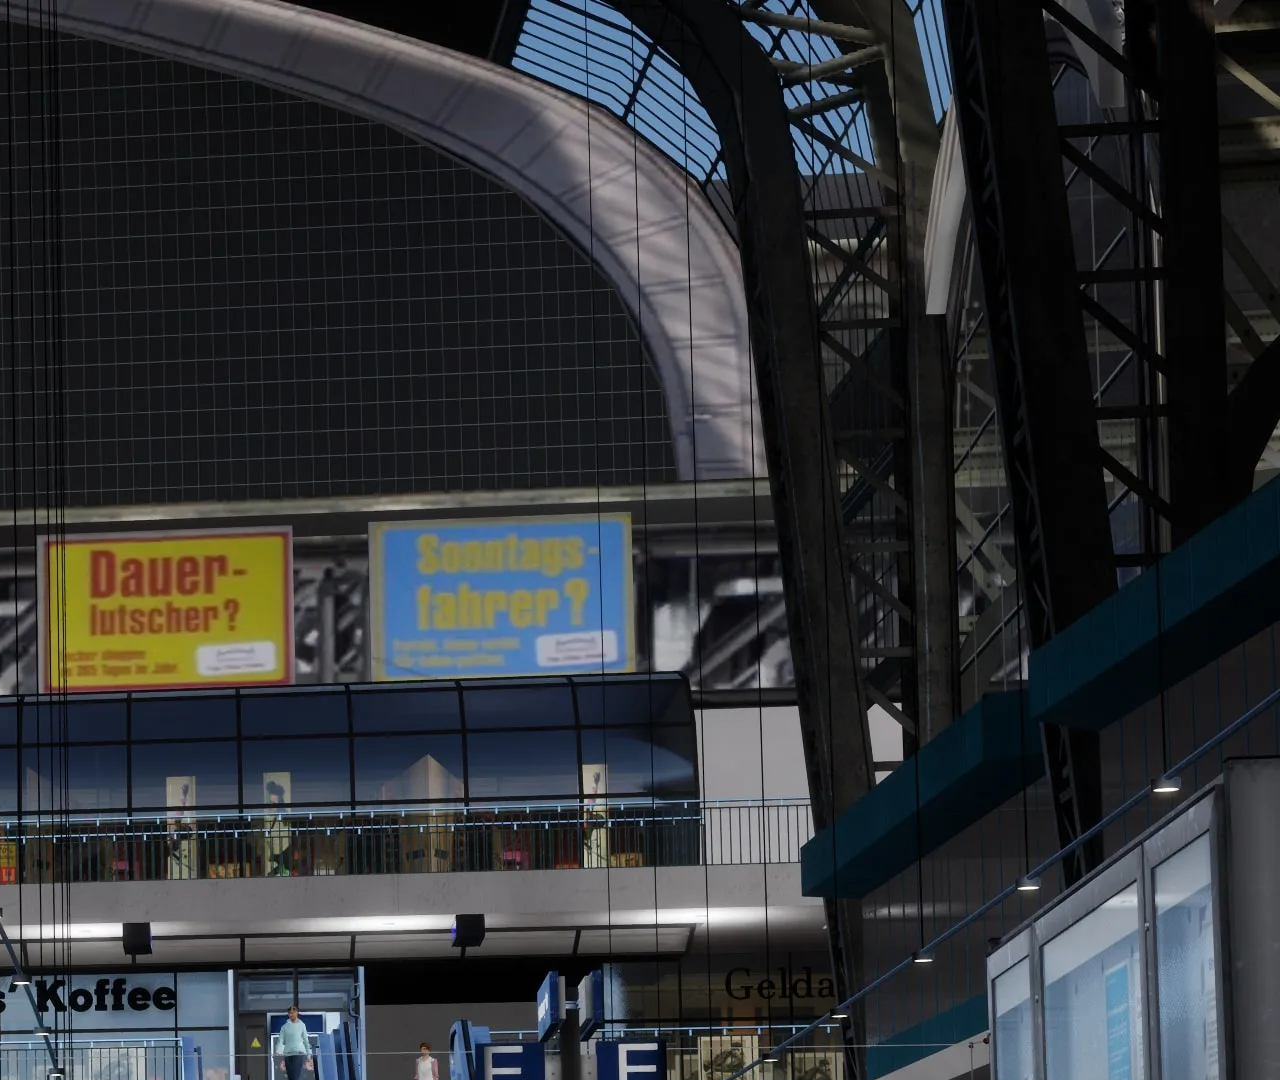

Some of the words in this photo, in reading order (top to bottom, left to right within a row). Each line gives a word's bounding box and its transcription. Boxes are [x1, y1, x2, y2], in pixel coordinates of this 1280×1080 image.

[89, 547, 248, 601] Dauer-
[417, 533, 600, 576] Sonntags-
[89, 598, 241, 637] lutscher?
[416, 578, 588, 631] fahrer?
[35, 977, 177, 1014] Koffee
[724, 966, 836, 1001] Gelda
